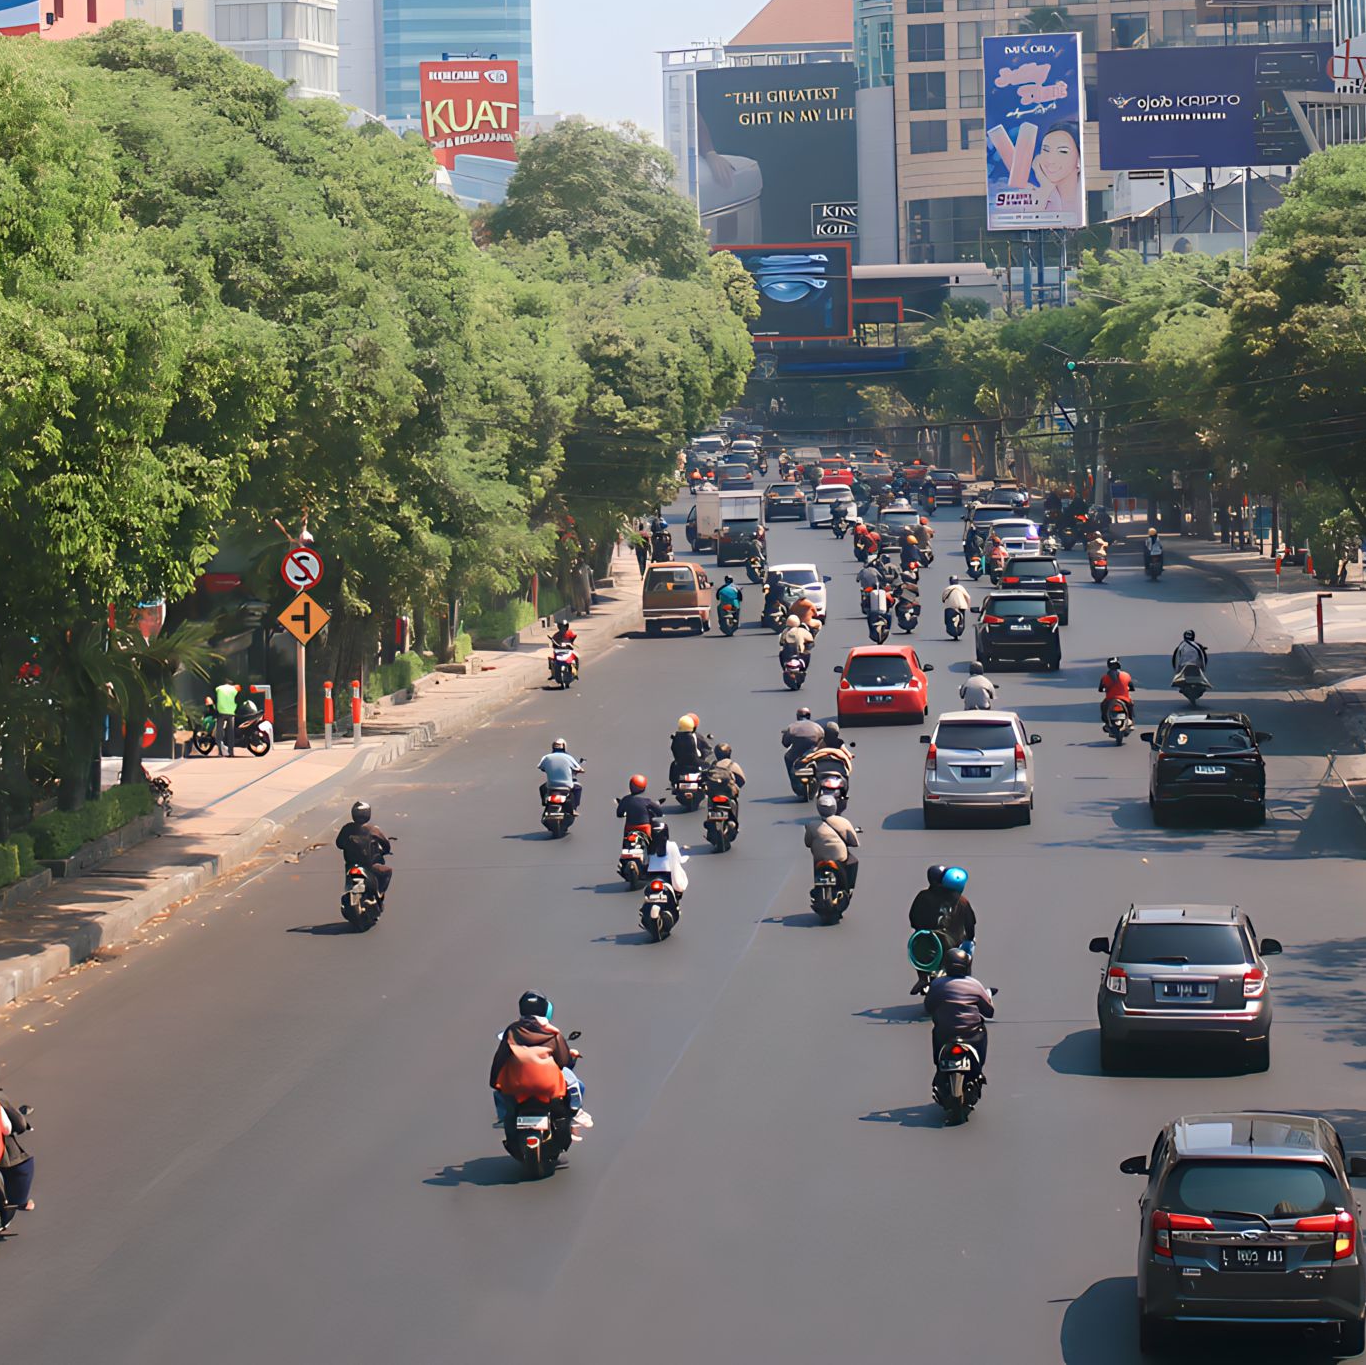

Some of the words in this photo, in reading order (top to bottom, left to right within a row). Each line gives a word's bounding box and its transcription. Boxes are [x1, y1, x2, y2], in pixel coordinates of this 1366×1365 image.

[424, 99, 518, 138] KUAT
[739, 111, 773, 125] GIFT
[778, 111, 795, 124] IN
[800, 108, 821, 122] MY
